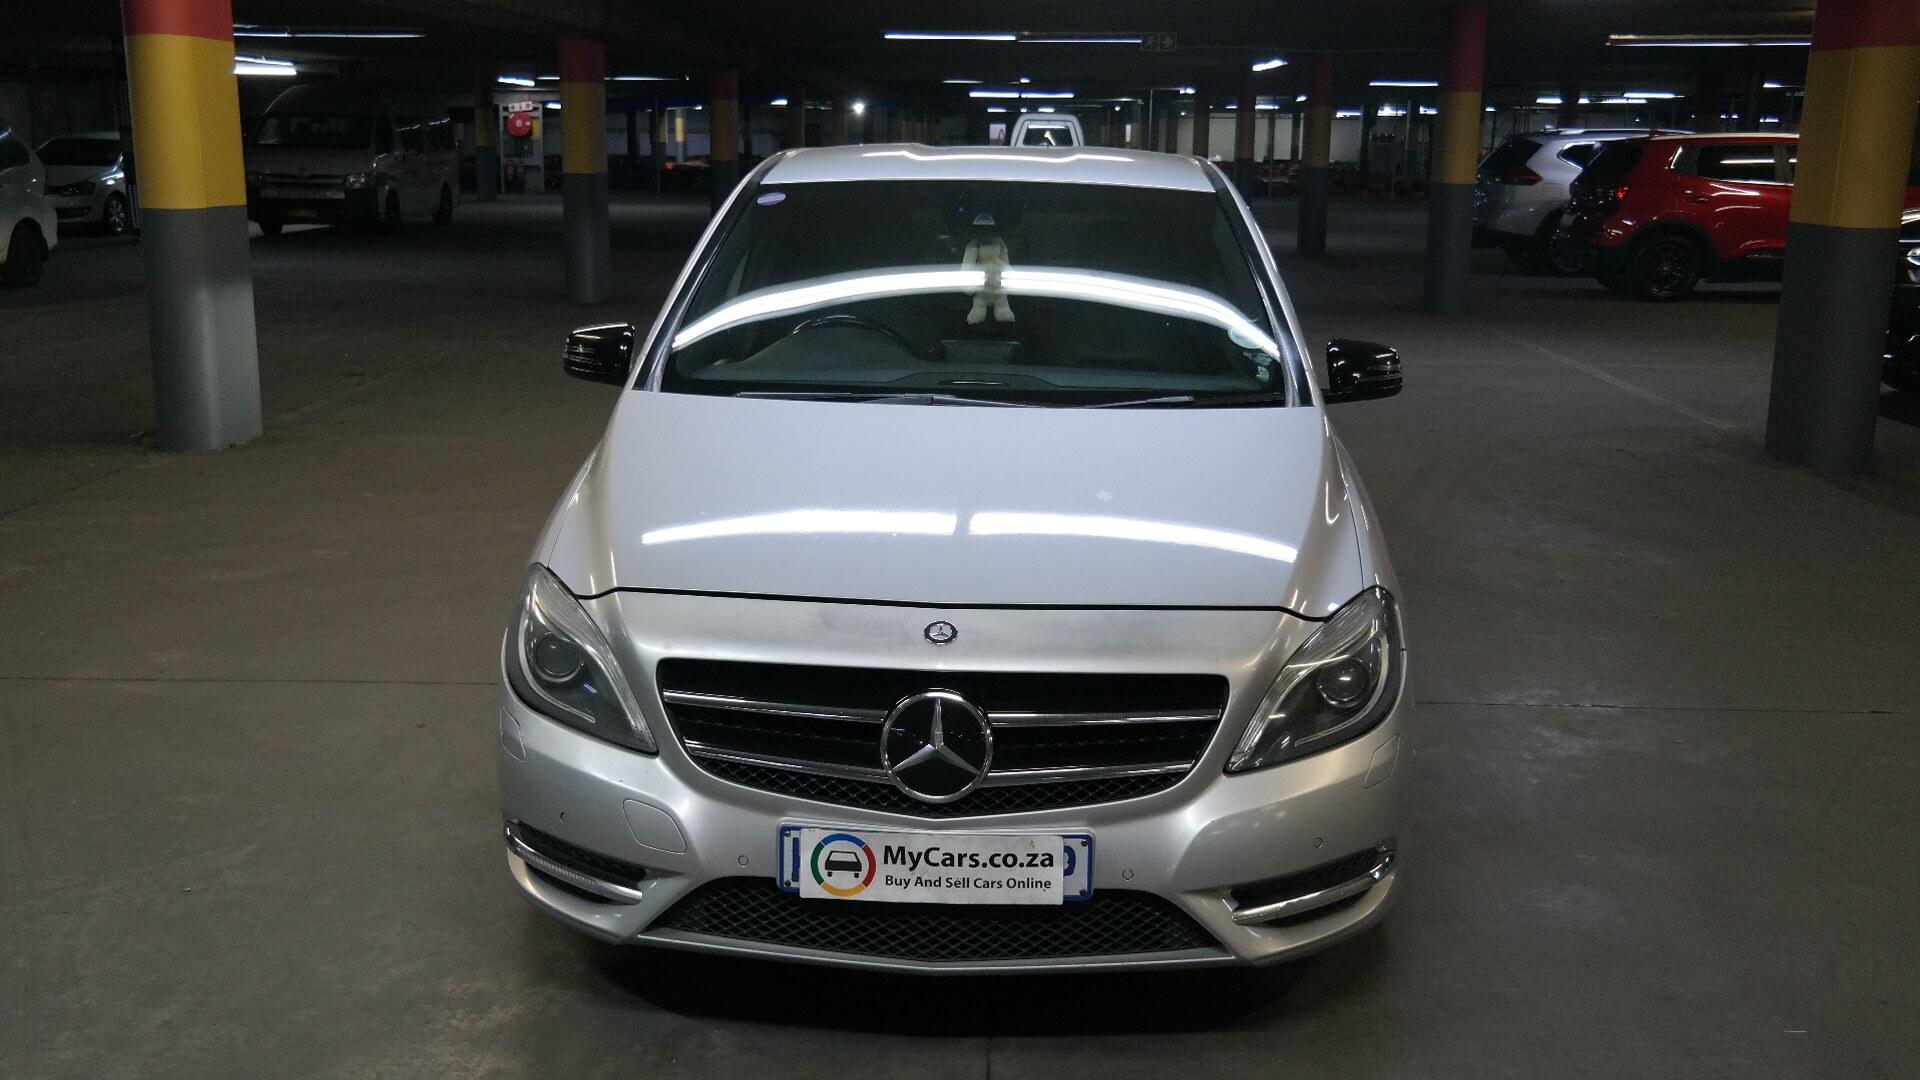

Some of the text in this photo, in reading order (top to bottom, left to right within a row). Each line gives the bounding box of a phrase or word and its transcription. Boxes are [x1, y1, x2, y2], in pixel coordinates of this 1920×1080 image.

[883, 845, 1054, 872] MyCars.co.za
[885, 875, 1052, 889] Buy And Sell Cars Online
